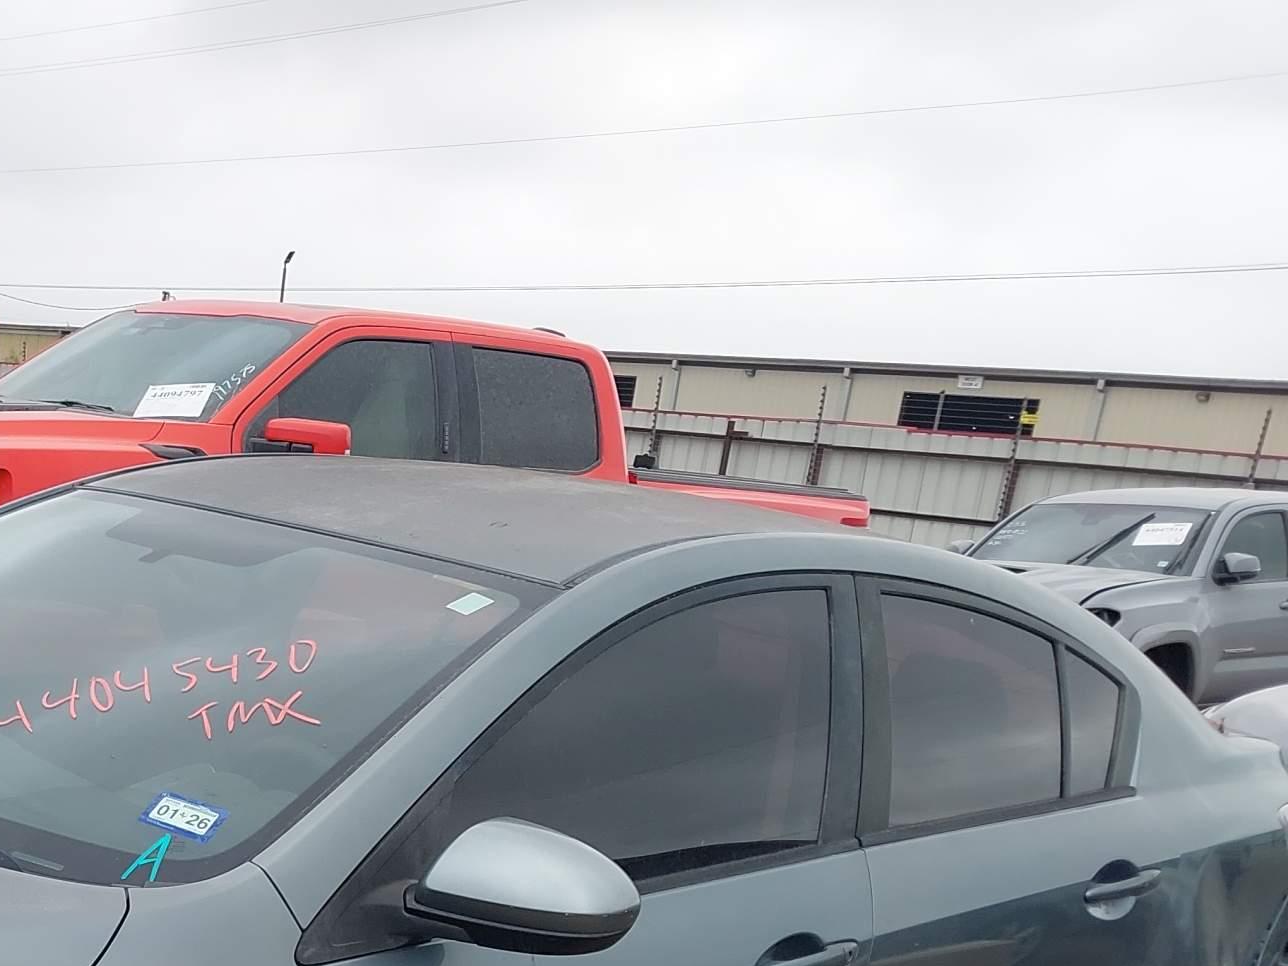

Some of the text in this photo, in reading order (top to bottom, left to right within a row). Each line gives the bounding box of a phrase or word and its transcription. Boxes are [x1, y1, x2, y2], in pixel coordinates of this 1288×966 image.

[187, 690, 321, 740] TMX
[157, 804, 180, 819] 01
[185, 814, 211, 830] 26
[120, 833, 172, 882] A
